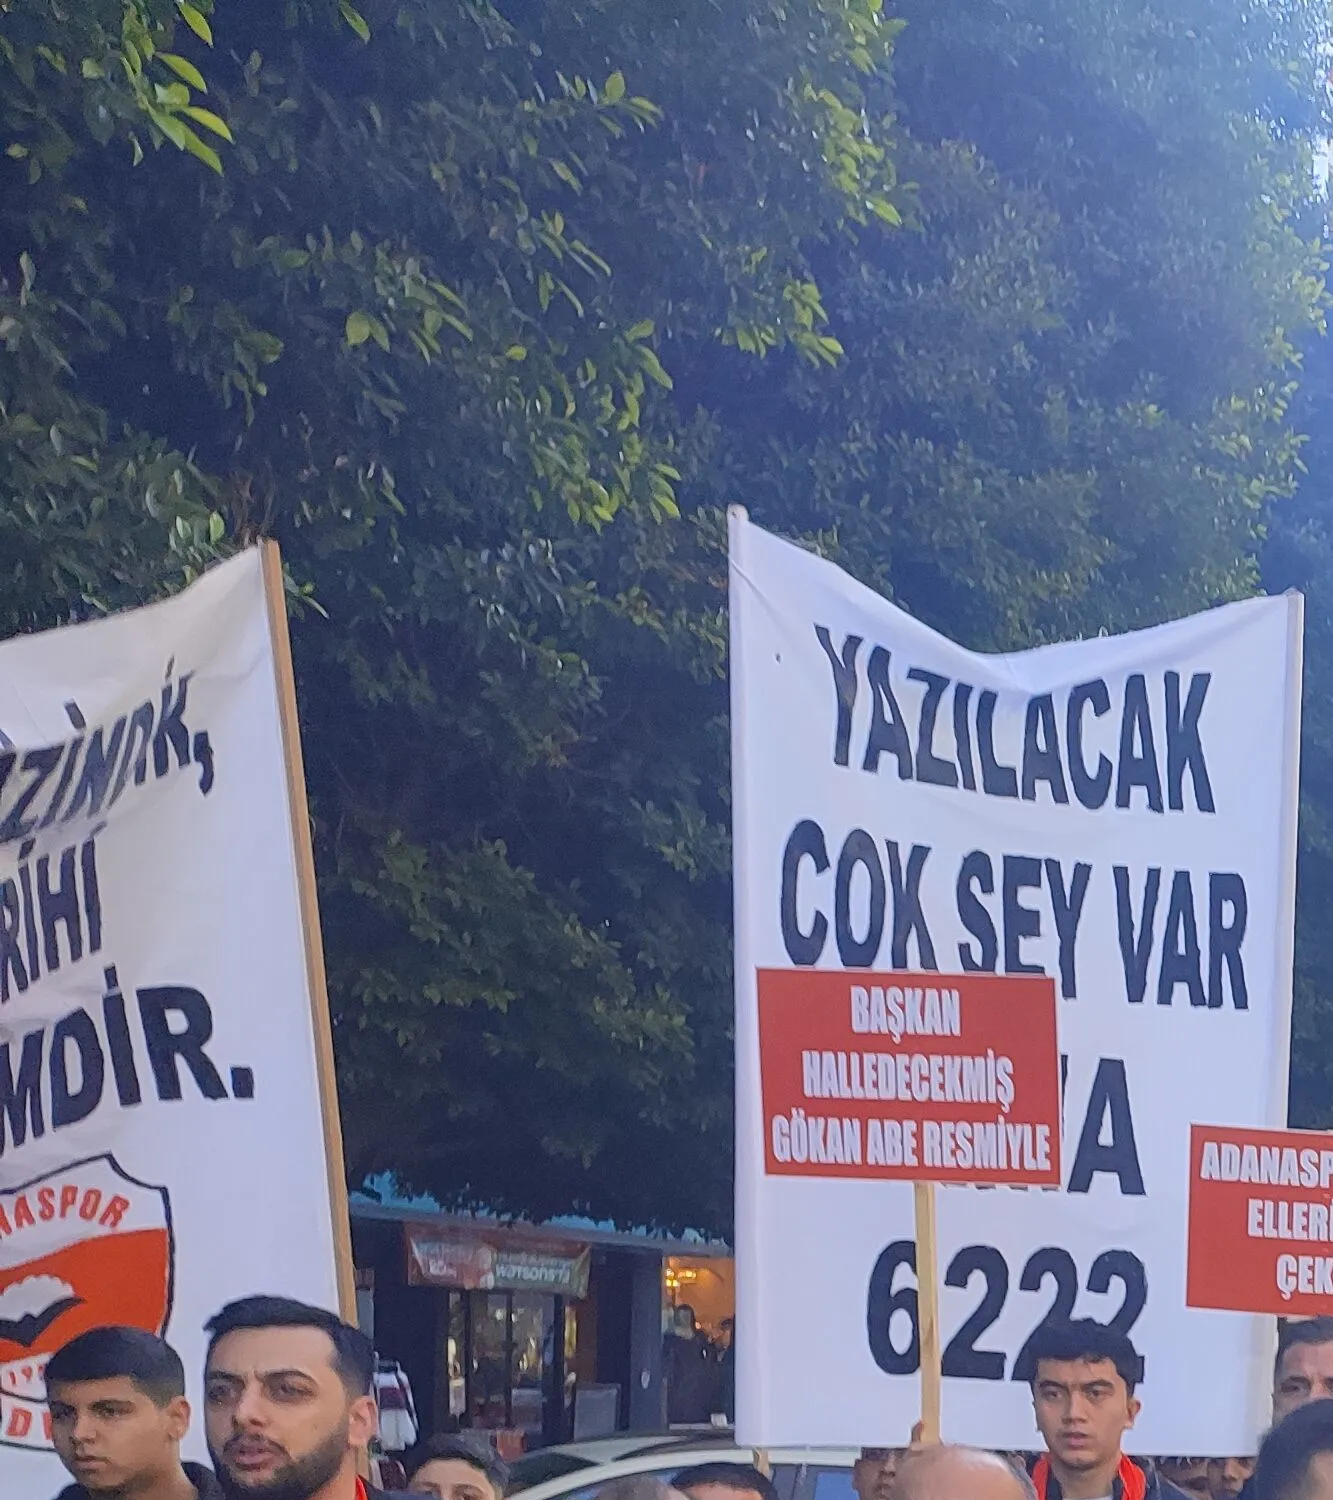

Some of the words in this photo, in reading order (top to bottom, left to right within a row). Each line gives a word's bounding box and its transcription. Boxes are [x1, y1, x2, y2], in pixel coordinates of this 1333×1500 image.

[815, 623, 1215, 814] YAZILACAK
[1113, 865, 1249, 1010] VAR
[850, 985, 961, 1044] BAŞKAN
[802, 1048, 1015, 1113] HALLEDECEKMİŞ
[772, 1107, 862, 1165] GÖKAN
[867, 1118, 918, 1166] ABE
[923, 1115, 1051, 1171] RESMİYLE
